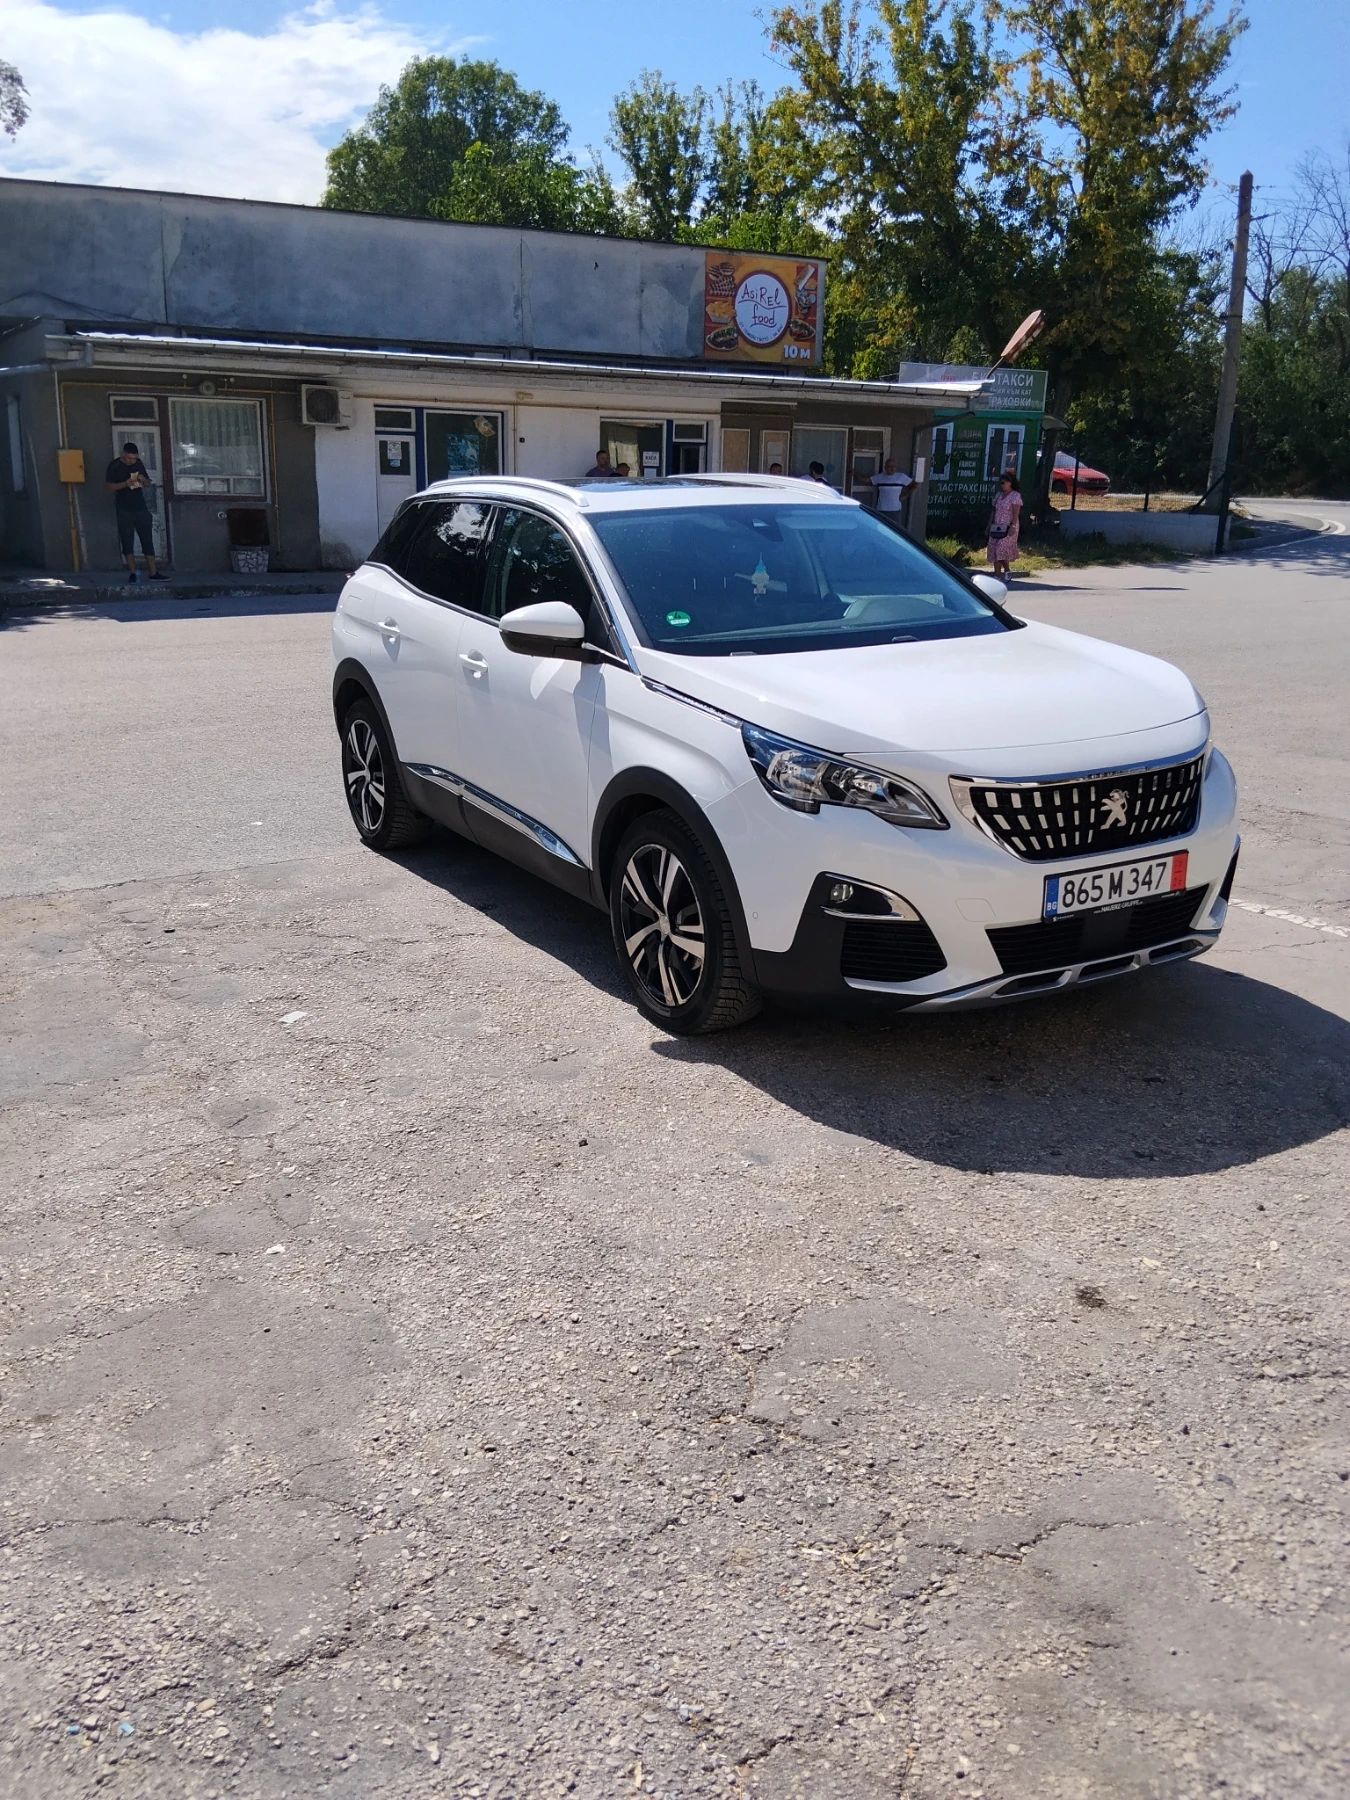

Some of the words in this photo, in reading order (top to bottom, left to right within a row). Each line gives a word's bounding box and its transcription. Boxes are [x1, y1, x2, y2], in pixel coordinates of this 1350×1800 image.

[751, 304, 776, 324] food
[783, 345, 798, 358] 10
[1046, 901, 1058, 911] BG
[1062, 874, 1104, 908] 865
[1127, 861, 1167, 895] 347
